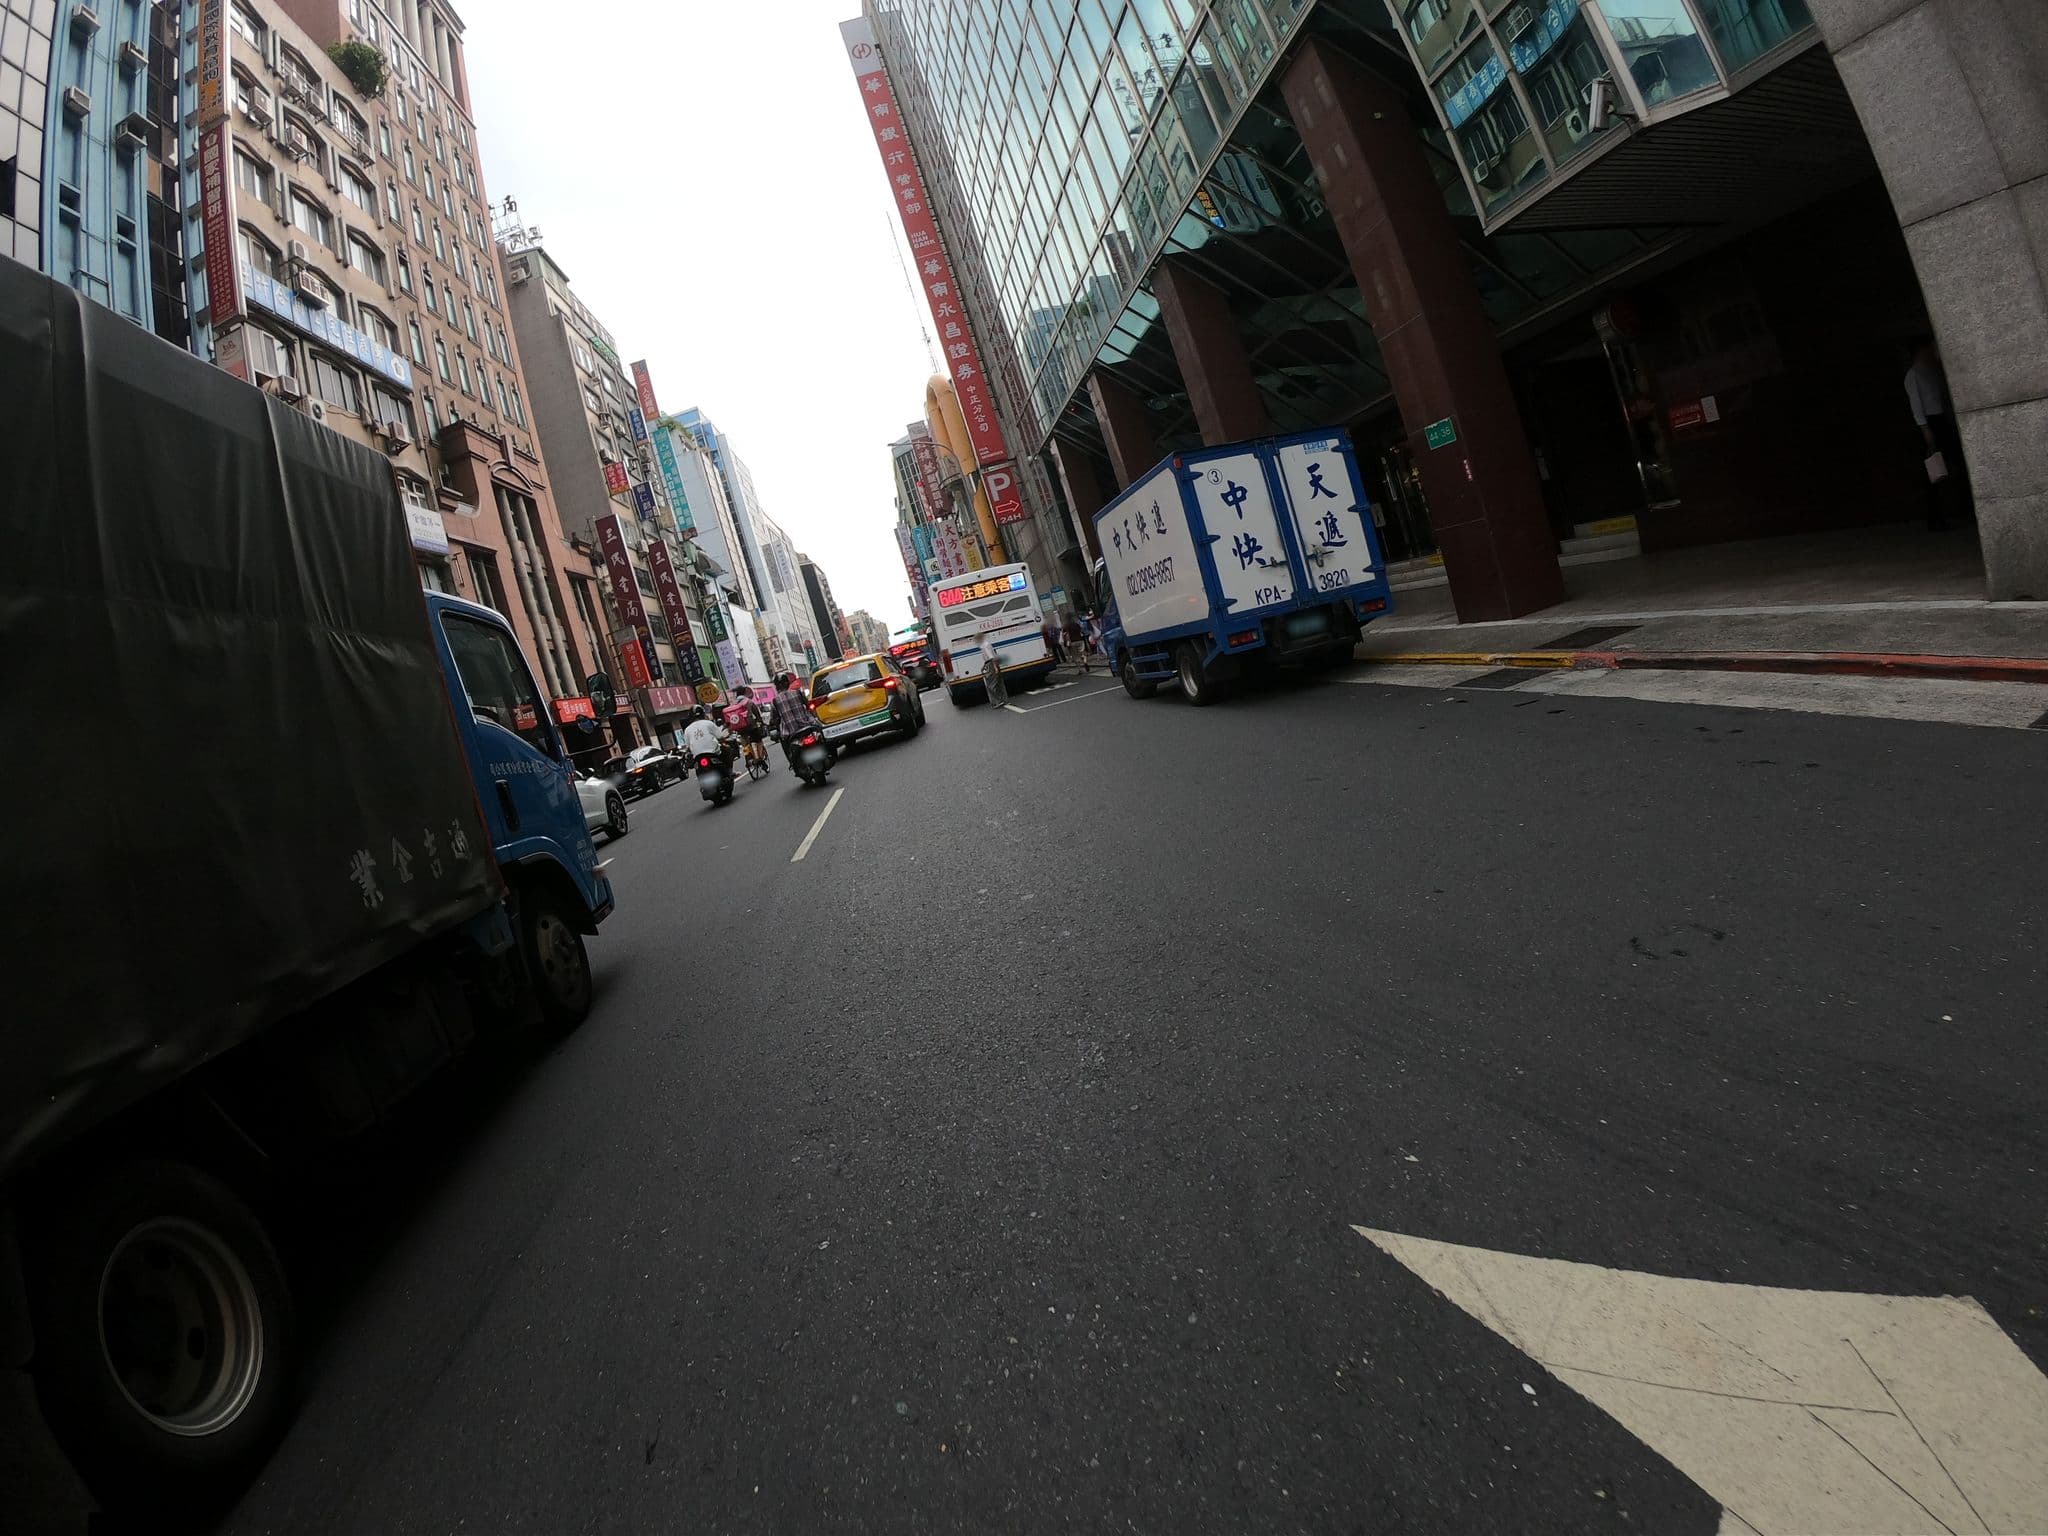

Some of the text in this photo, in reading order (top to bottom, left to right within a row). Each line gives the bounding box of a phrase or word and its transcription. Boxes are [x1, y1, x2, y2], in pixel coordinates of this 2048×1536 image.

[865, 78, 905, 165] 華南銀行
[204, 144, 223, 218] 國家補習班
[924, 259, 976, 381] 華南永昌證券
[967, 385, 989, 433] 中正分公司
[987, 472, 1011, 502] P
[1000, 512, 1022, 524] 24H
[1113, 499, 1167, 560] 中天快遞
[605, 527, 639, 618] 三民書局
[655, 551, 684, 627] 三民書局
[962, 576, 1010, 601] 注意乘客
